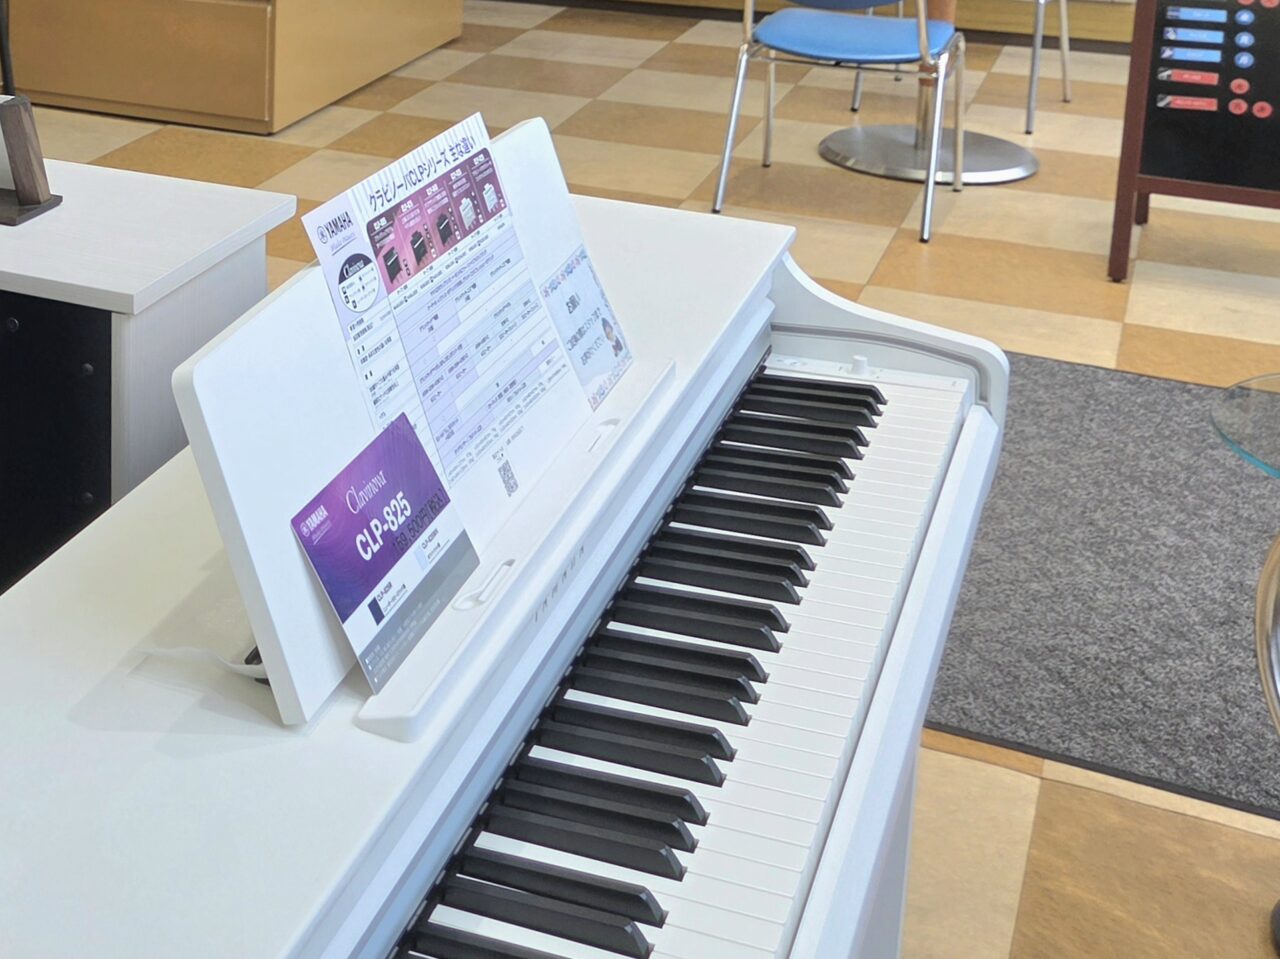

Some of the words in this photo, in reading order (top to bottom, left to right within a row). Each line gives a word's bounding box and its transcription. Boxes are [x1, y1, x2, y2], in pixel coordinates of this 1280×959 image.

[325, 211, 354, 239] YAMAHA
[345, 470, 388, 515] Clavinova
[355, 491, 412, 561] CLP-825
